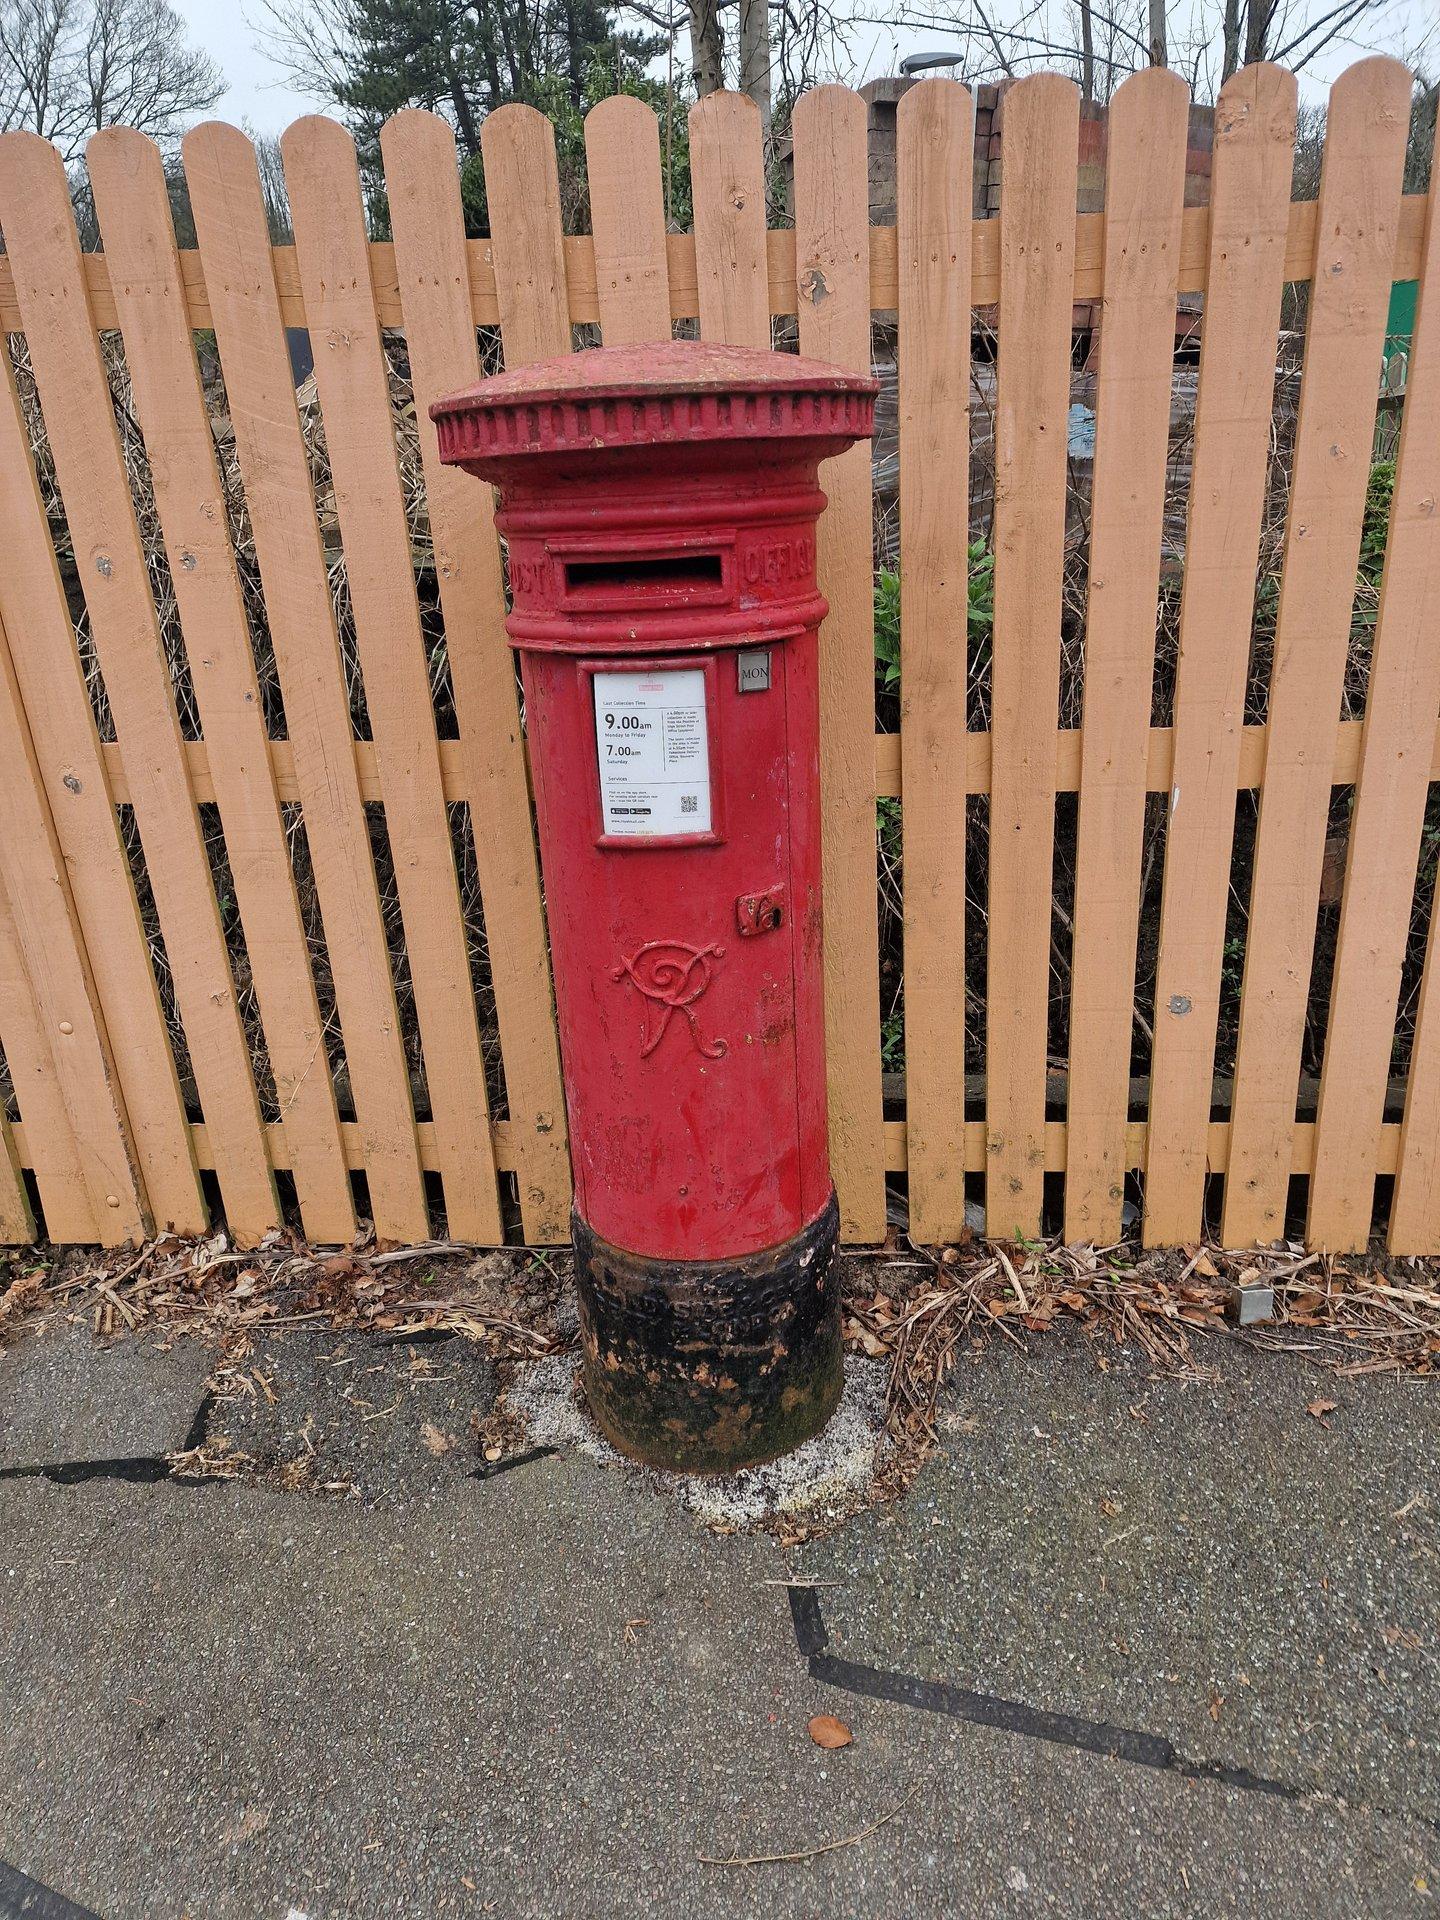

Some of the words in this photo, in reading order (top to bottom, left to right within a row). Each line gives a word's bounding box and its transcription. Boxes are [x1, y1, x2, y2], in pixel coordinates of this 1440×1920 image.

[742, 667, 768, 679] MON
[605, 713, 652, 730] 9.00am
[606, 744, 641, 756] 7.00am
